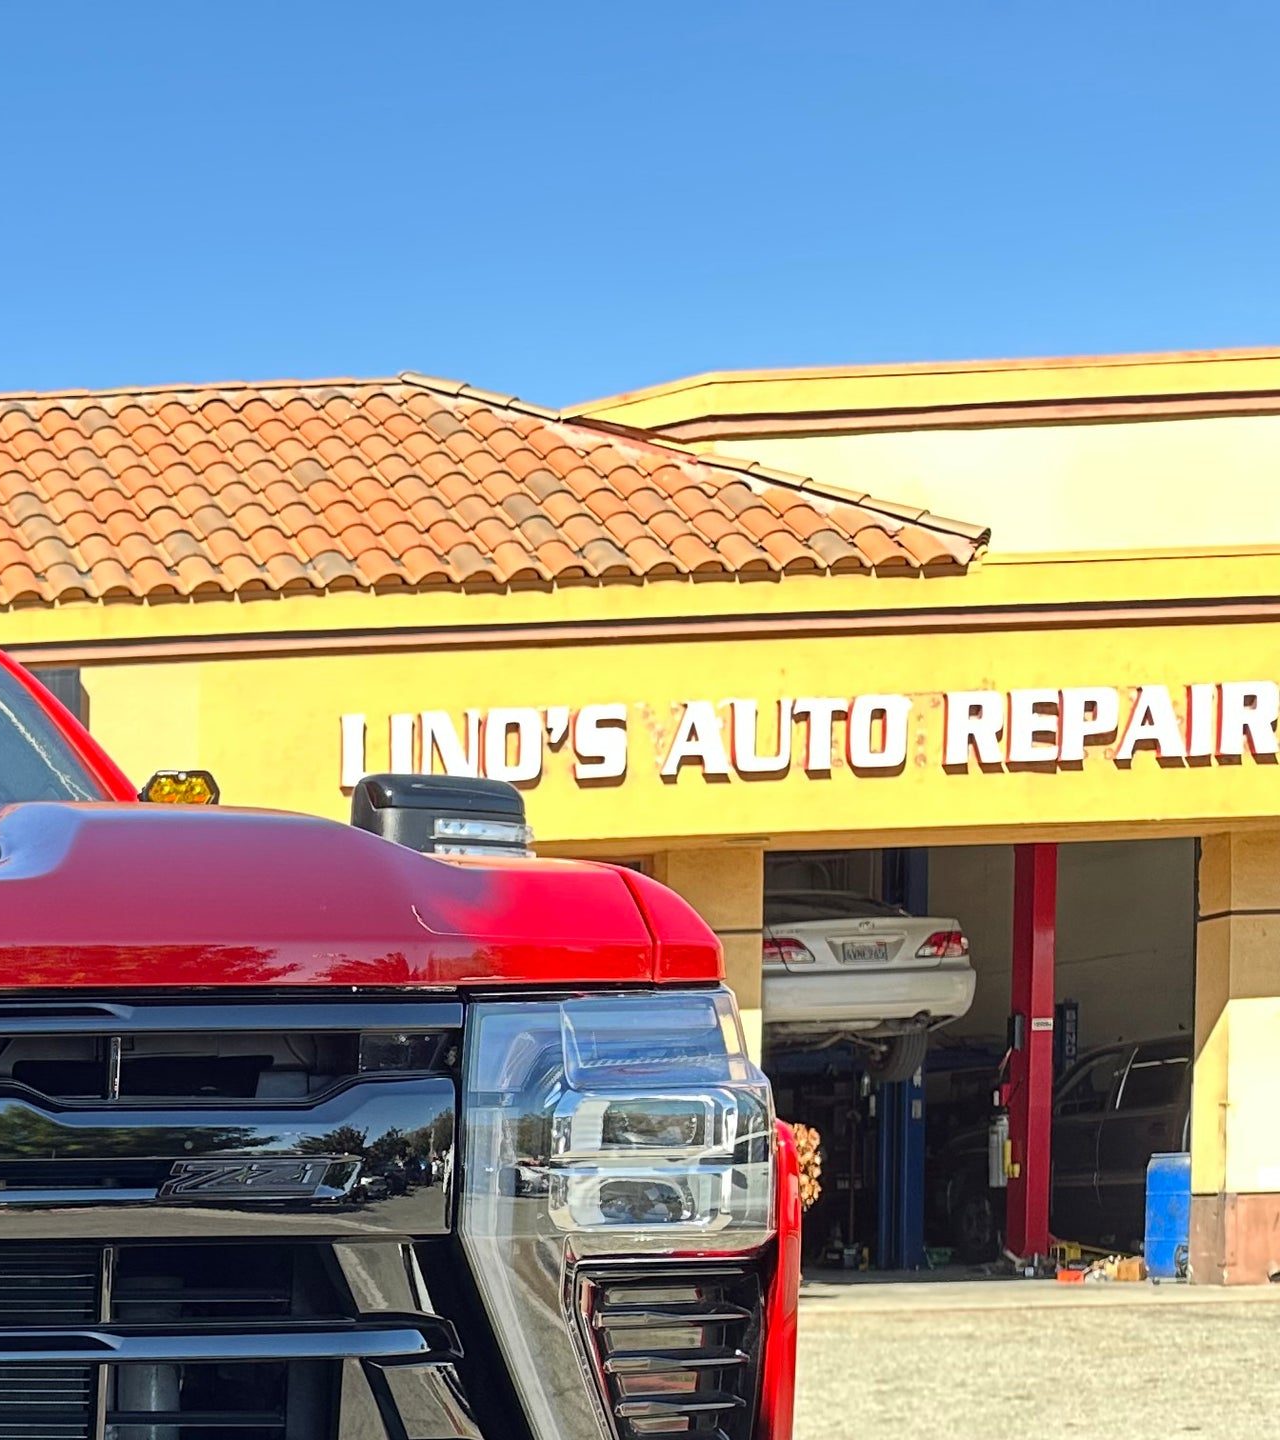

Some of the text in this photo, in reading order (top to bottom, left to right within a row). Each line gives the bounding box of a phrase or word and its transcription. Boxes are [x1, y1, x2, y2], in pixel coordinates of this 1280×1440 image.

[340, 681, 1280, 792] LINO'S AUTO REPAIR
